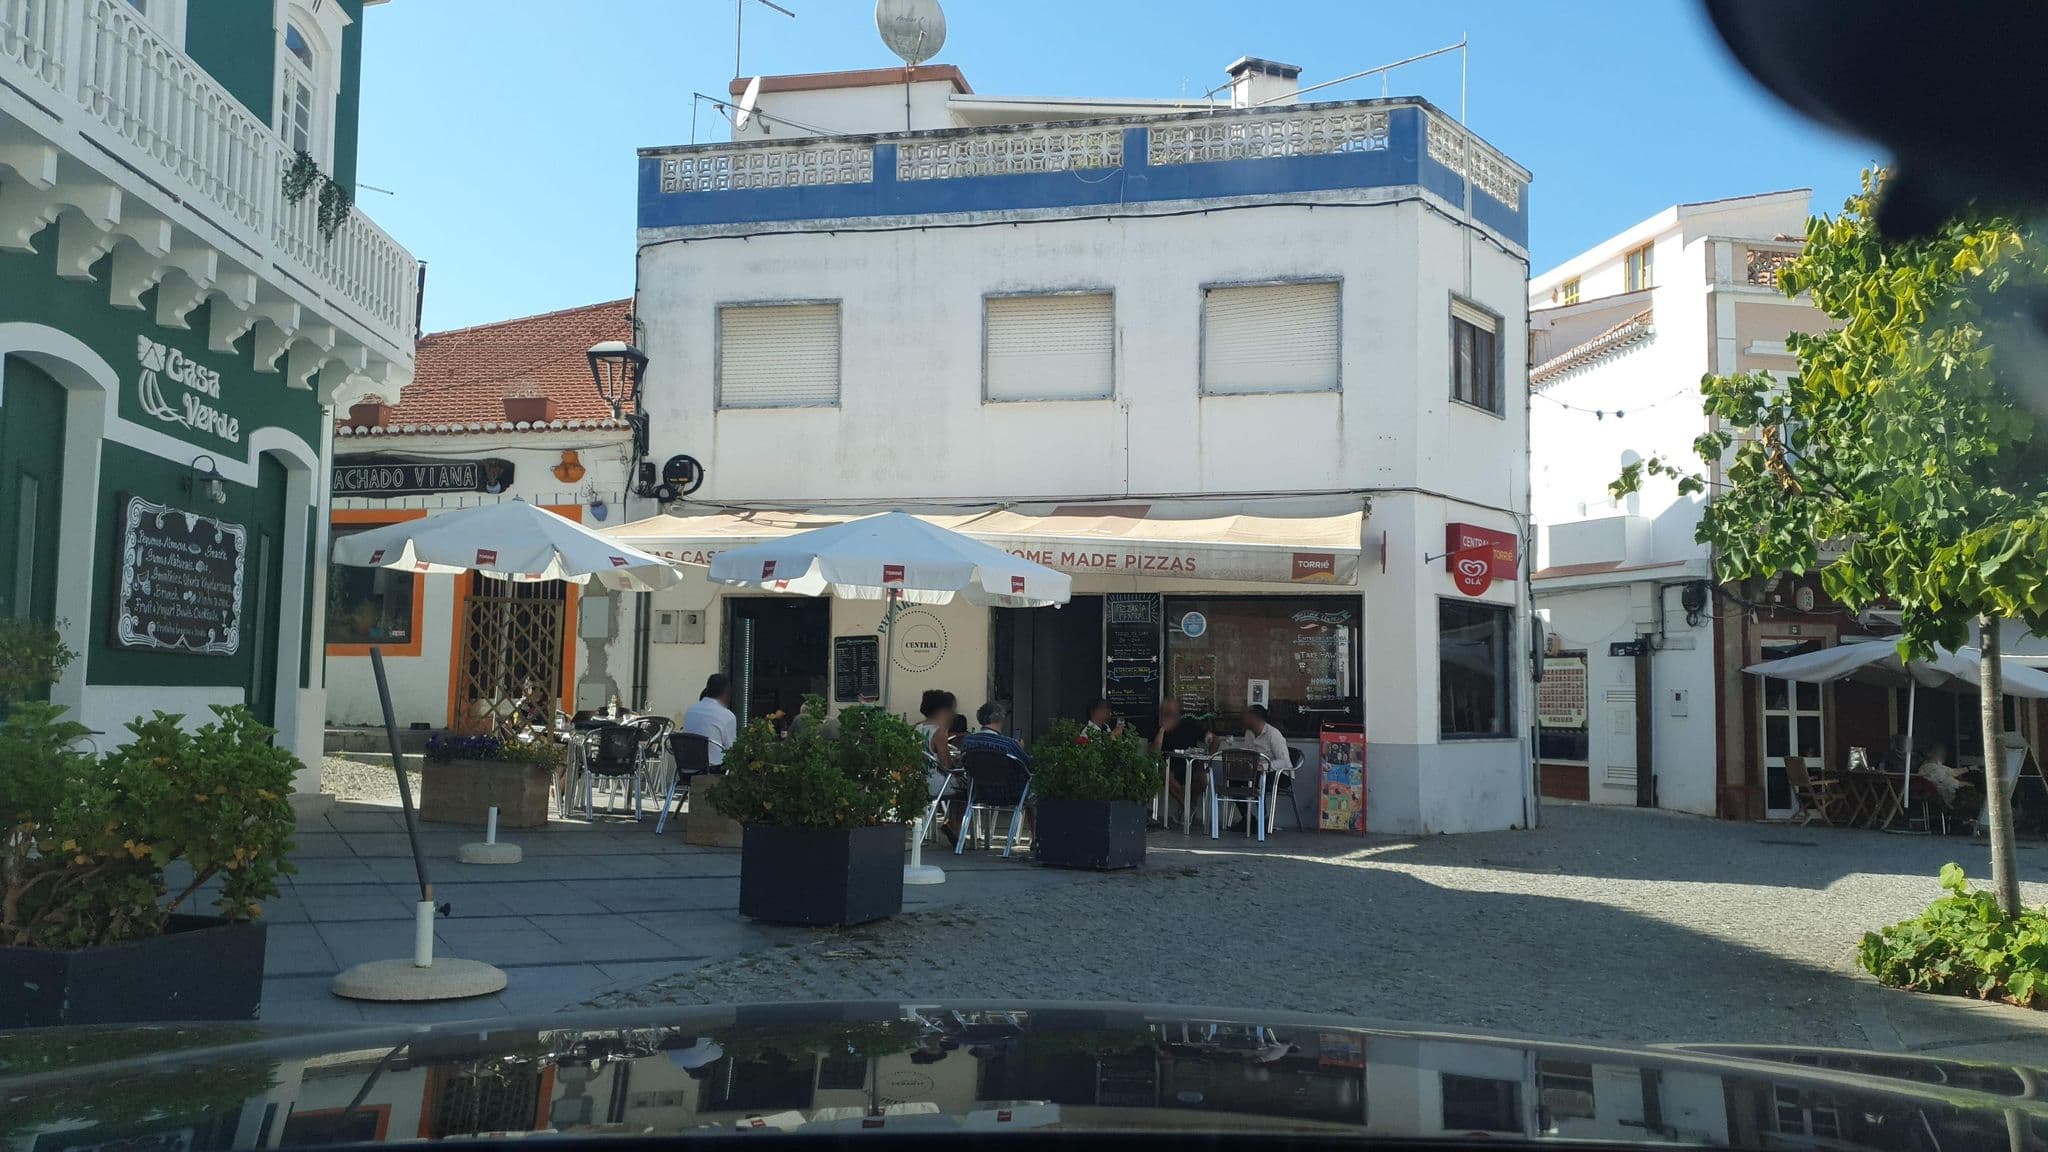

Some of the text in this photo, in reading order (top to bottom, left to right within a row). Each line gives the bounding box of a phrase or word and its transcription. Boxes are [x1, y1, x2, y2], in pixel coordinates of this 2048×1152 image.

[165, 347, 220, 400] Casa
[182, 391, 240, 444] Verde
[333, 466, 475, 490] ACHADO VIANA
[1060, 552, 1117, 568] MADE
[1125, 554, 1197, 571] PIZZAS
[905, 641, 938, 649] CENTRAL
